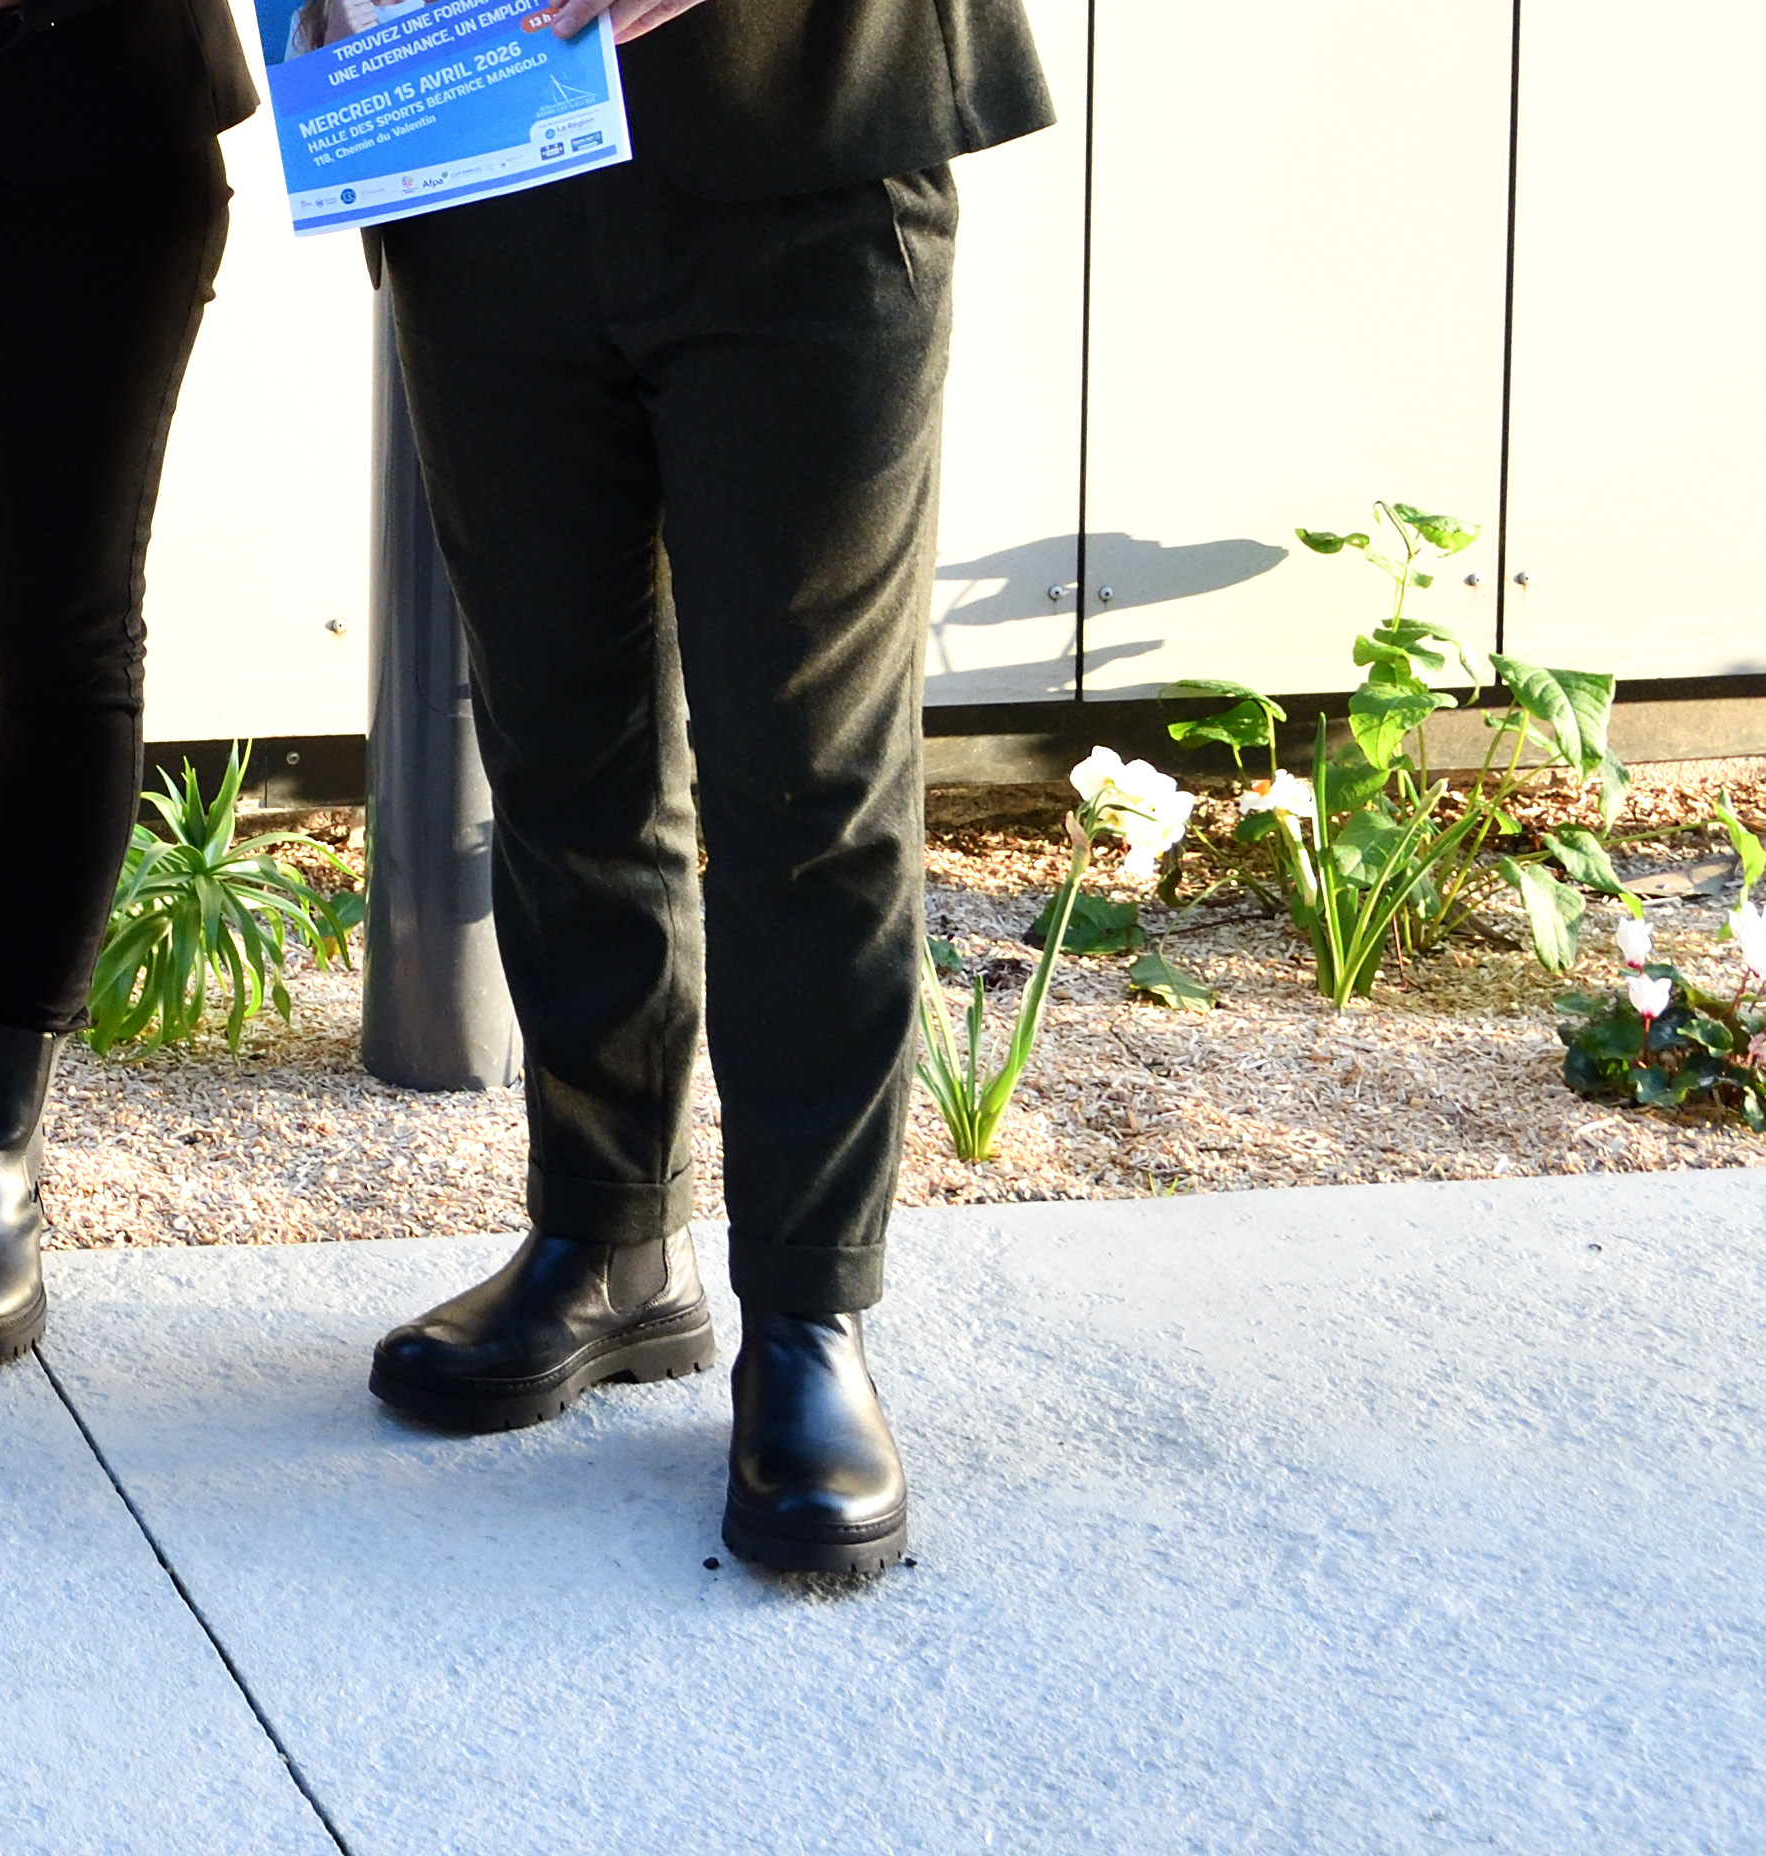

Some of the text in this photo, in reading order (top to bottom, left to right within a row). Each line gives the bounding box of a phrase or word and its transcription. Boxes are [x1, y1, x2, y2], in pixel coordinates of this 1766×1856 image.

[327, 64, 358, 87] UNE
[359, 27, 455, 75] ALTERNANCE,
[454, 18, 477, 37] UN
[332, 23, 401, 62] TROUVEZ
[400, 11, 433, 35] UNE
[298, 40, 522, 139] MERCREDI 15 AVRIL 2026
[307, 51, 548, 154] HALLE DES SPORTS BÉATRICE MANGOLD
